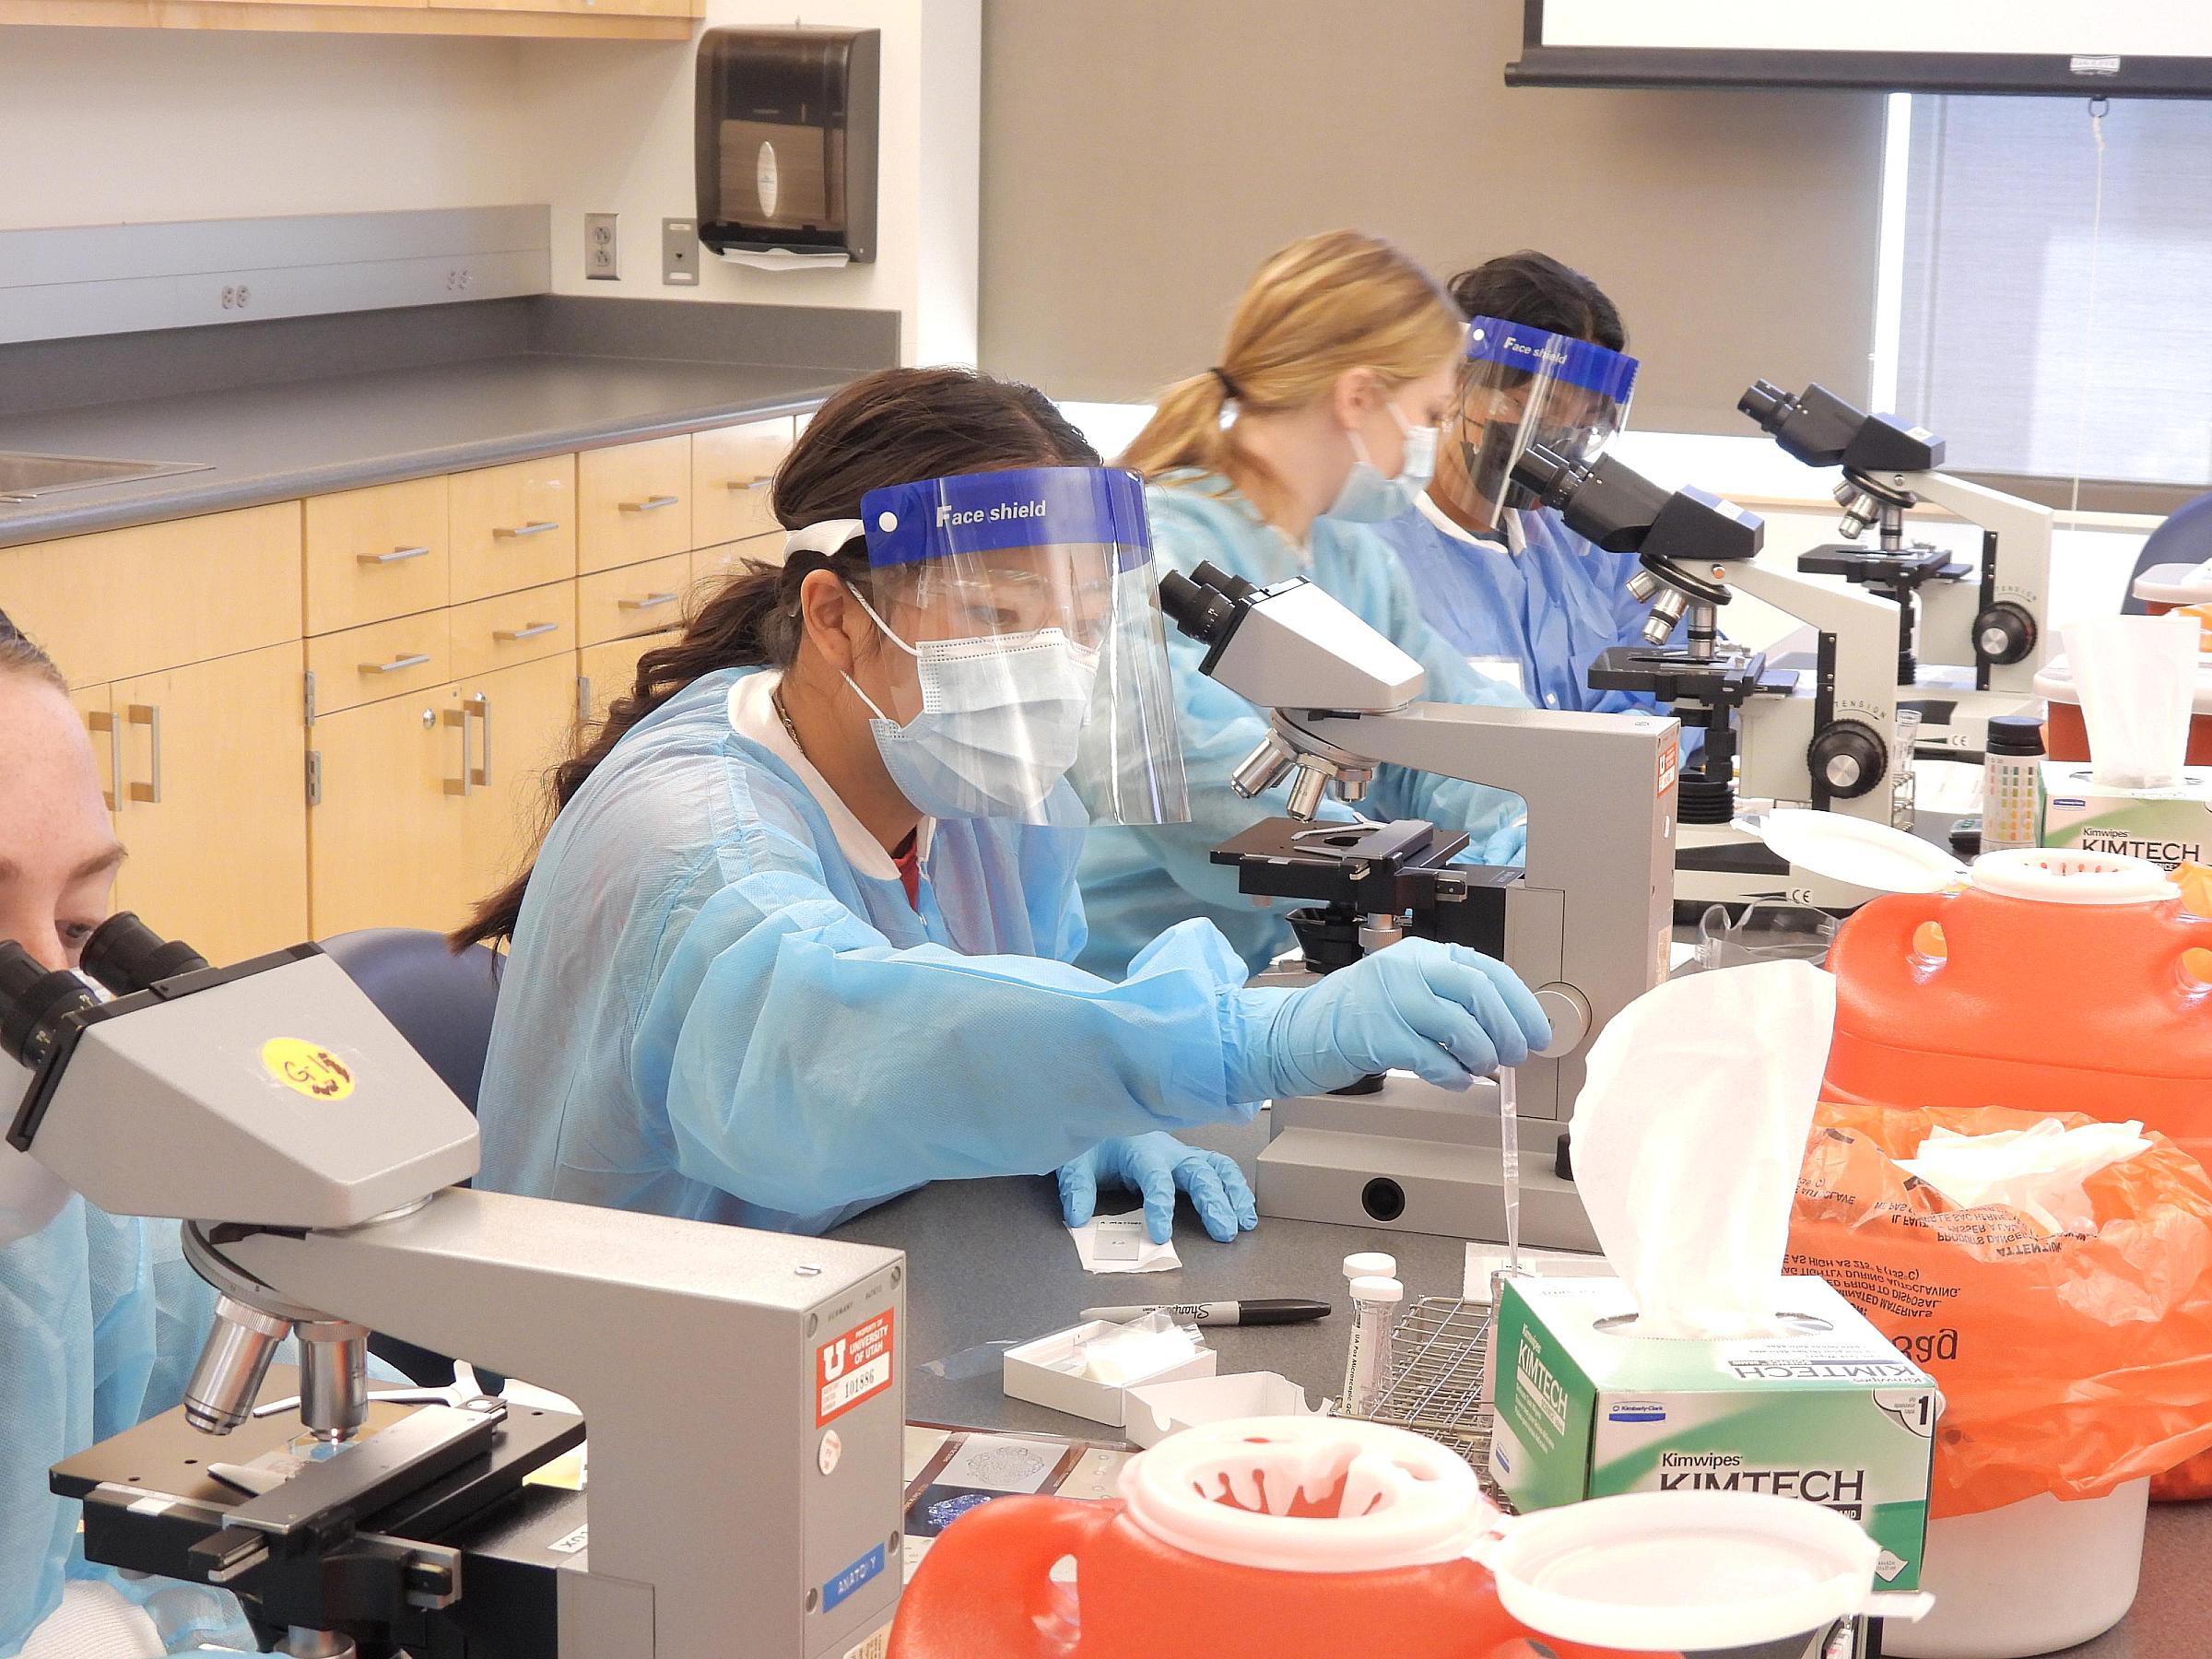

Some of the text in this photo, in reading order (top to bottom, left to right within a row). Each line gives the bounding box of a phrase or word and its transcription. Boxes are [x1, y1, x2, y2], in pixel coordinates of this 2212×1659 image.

[1502, 335, 1568, 365] Face shield
[935, 500, 1046, 528] Face shield
[2083, 827, 2128, 839] Kimwipes
[2082, 839, 2200, 862] KIMTECH
[849, 1324, 888, 1355] UNIVERSITY
[853, 1339, 883, 1365] OF UTAH
[823, 1337, 847, 1382] U
[1734, 1366, 1916, 1379] KIMTECH
[1347, 1359, 1358, 1402] Microscopic
[1518, 1337, 1569, 1421] KIMTECH
[1918, 1395, 1929, 1426] 1
[1662, 1452, 1741, 1470] Kimwipes
[1659, 1469, 1865, 1501] KIMTECH
